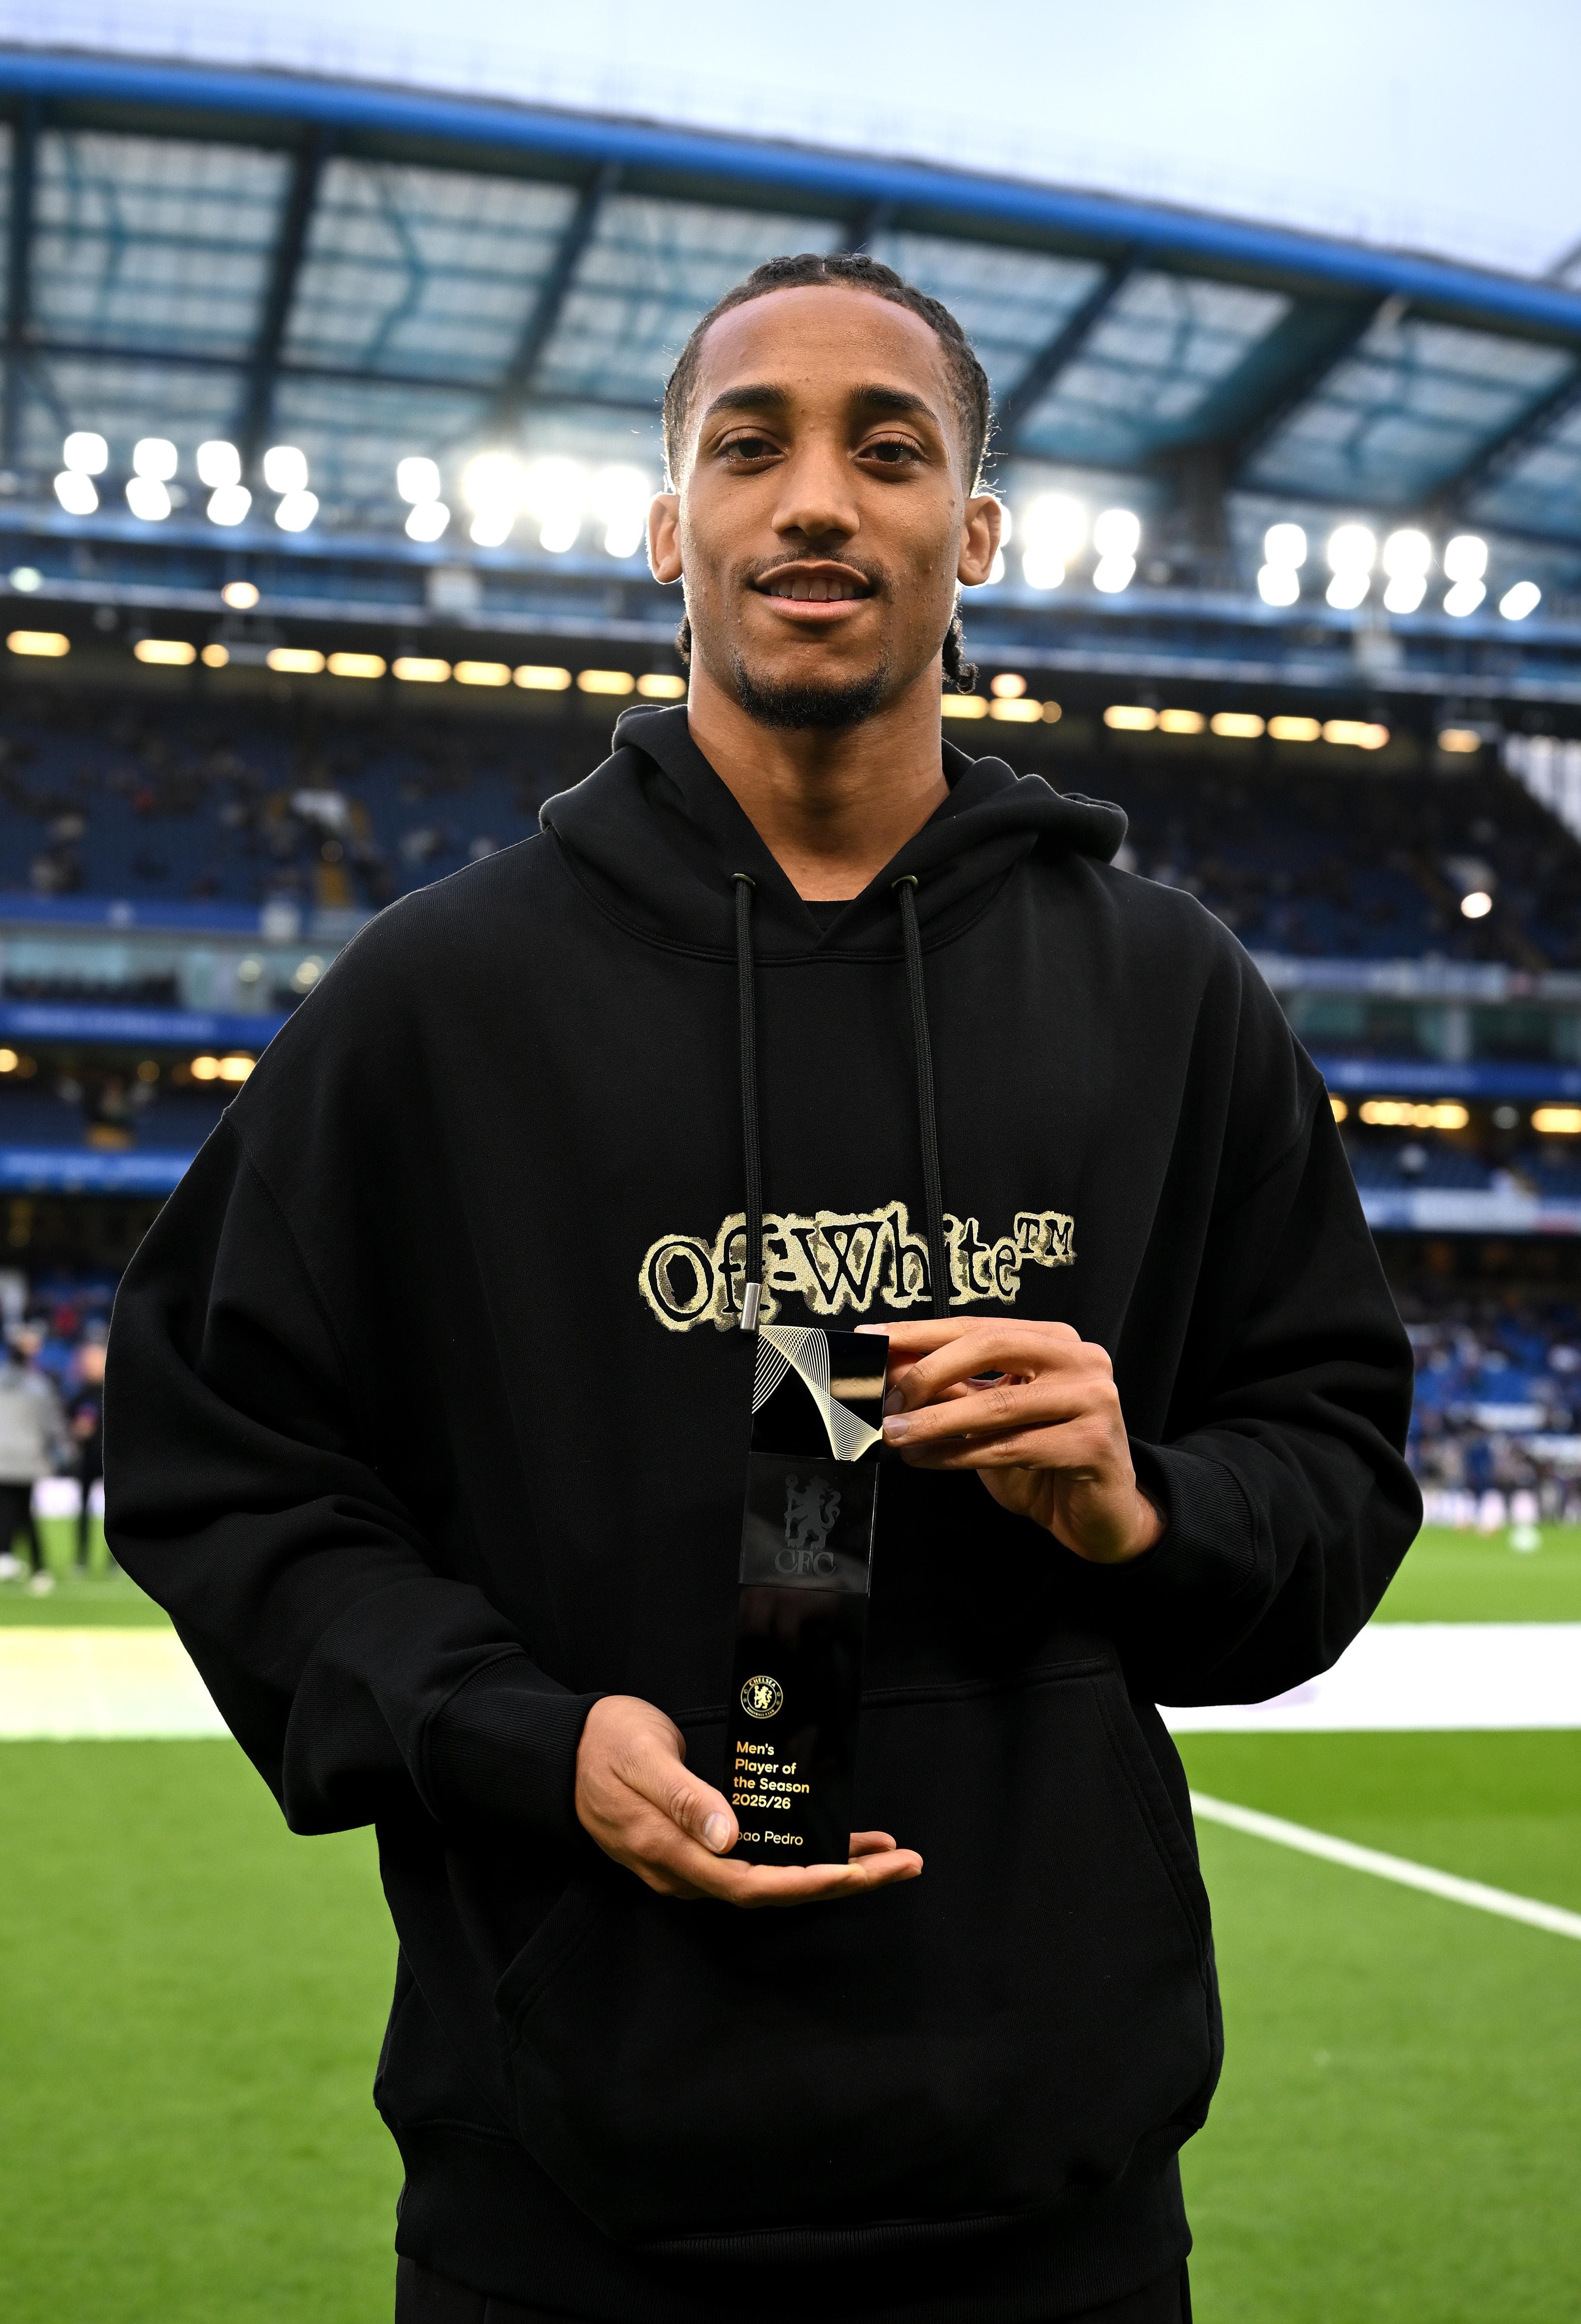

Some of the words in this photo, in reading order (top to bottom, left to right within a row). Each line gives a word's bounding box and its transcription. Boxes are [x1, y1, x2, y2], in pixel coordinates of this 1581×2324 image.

[775, 1549, 836, 1577] CFC
[749, 1677, 776, 1688] CHELSEA
[737, 1740, 774, 1756] Men's
[735, 1758, 779, 1775] Player
[782, 1762, 797, 1775] of
[733, 1776, 756, 1789] the
[759, 1777, 810, 1794] Season
[732, 1793, 791, 1810] 2025/26
[737, 1831, 761, 1842] oao
[764, 1831, 803, 1846] Pedro
